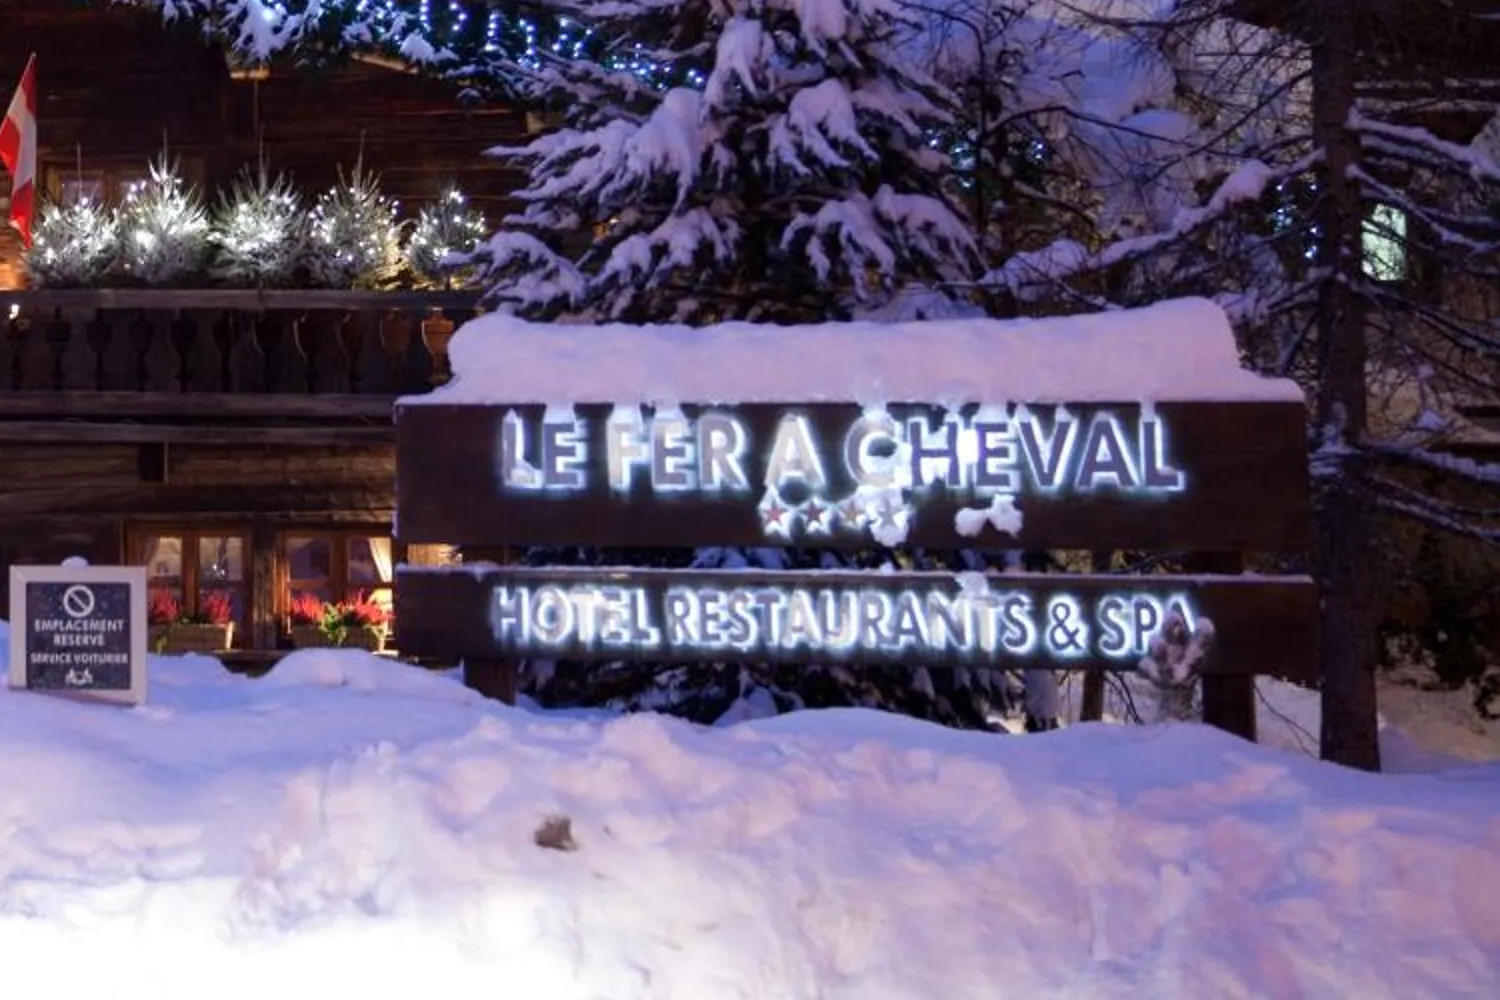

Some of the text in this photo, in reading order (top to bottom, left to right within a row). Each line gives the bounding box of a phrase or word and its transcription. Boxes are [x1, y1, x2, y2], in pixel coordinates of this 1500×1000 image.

[502, 411, 586, 490] LE
[605, 411, 749, 490] FER
[843, 408, 1185, 491] CHEVAL
[33, 618, 124, 632] EMPLACEMENT
[493, 585, 659, 646] HOTEL
[665, 586, 1036, 653] RESTAURANTS
[1049, 594, 1089, 655] &
[30, 652, 128, 665] SERVICE VOITURIER
